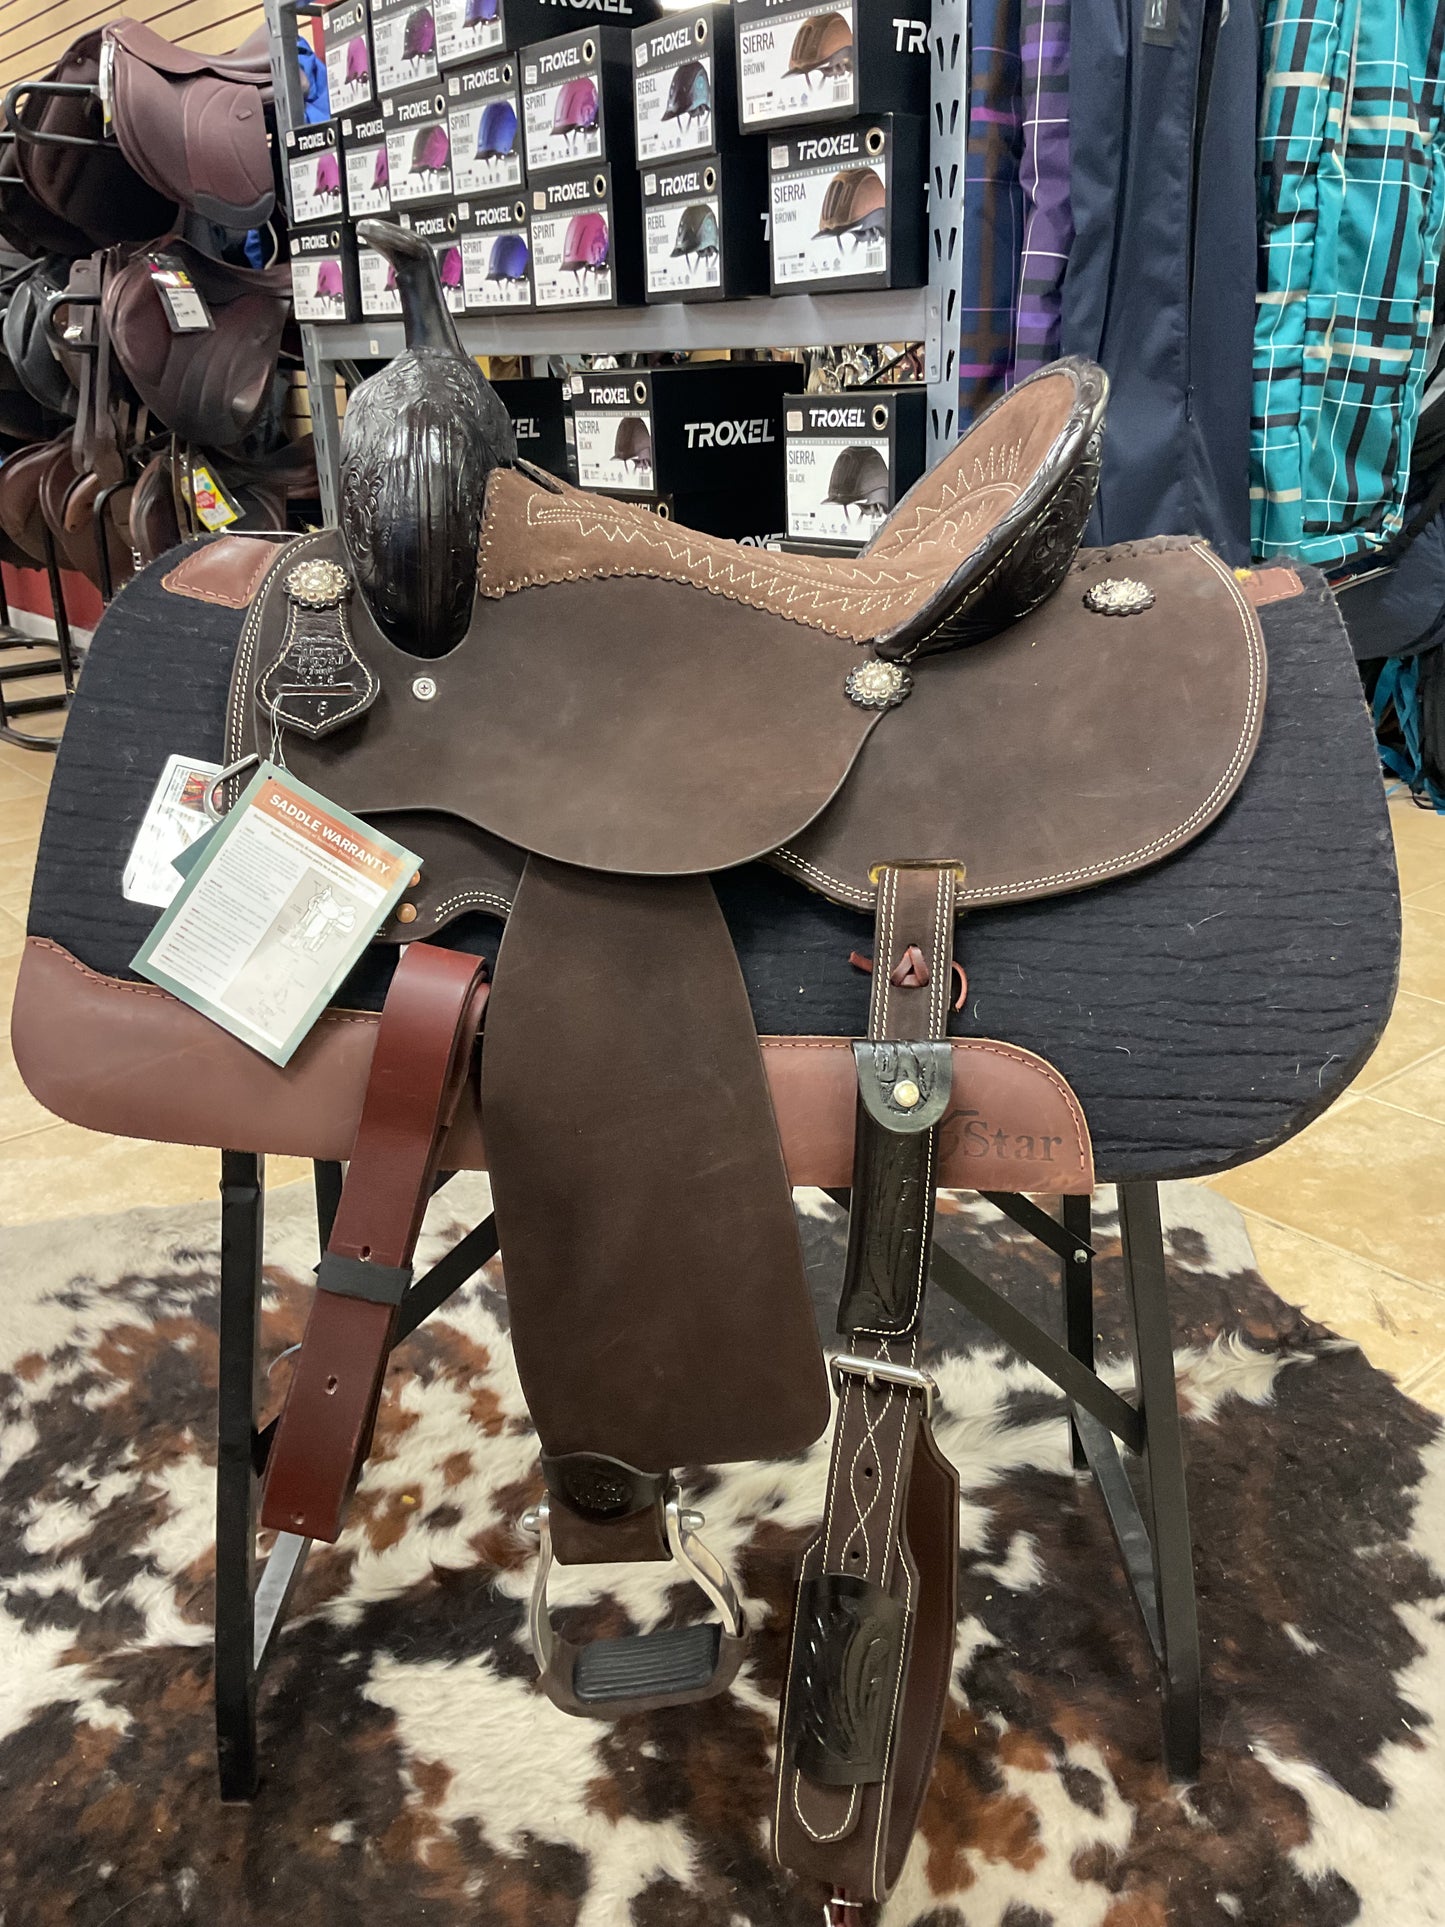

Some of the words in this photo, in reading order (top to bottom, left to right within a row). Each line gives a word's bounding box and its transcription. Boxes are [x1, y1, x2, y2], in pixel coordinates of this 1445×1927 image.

[333, 11, 355, 33] TROXEL
[650, 27, 692, 57] TROXEL
[743, 31, 775, 55] SIERRA
[892, 18, 931, 54] TR
[539, 47, 580, 74] TROXEL
[743, 61, 765, 77] BROWN
[462, 68, 500, 91] TROXEL
[637, 77, 657, 96] REBEL
[398, 100, 432, 121] TROXEL
[525, 93, 546, 111] SPIRIT
[356, 119, 384, 139] TROXEL
[450, 113, 470, 131] SPIRIT
[298, 133, 326, 151] TROXEL
[797, 133, 859, 161] TROXEL
[548, 181, 590, 203] TROXEL
[660, 172, 700, 197] TROXEL
[774, 183, 806, 204] SIERRA
[475, 206, 512, 226] TROXEL
[647, 214, 666, 231] REBEL
[775, 210, 797, 225] BROWN
[415, 218, 446, 236] TROXEL
[533, 223, 555, 240] SPIRIT
[301, 234, 329, 250] TROXEL
[463, 241, 482, 254] SPIRIT
[589, 387, 631, 404] TROXEL
[577, 420, 600, 434] SIERRA
[809, 409, 866, 427] TROXEL
[684, 418, 774, 449] TROXEL
[789, 450, 815, 465] SIERRA
[789, 474, 806, 483] BLACK
[270, 794, 322, 832] SADDLE
[322, 826, 390, 874] WARRANTY
[964, 1120, 1062, 1162] Star
